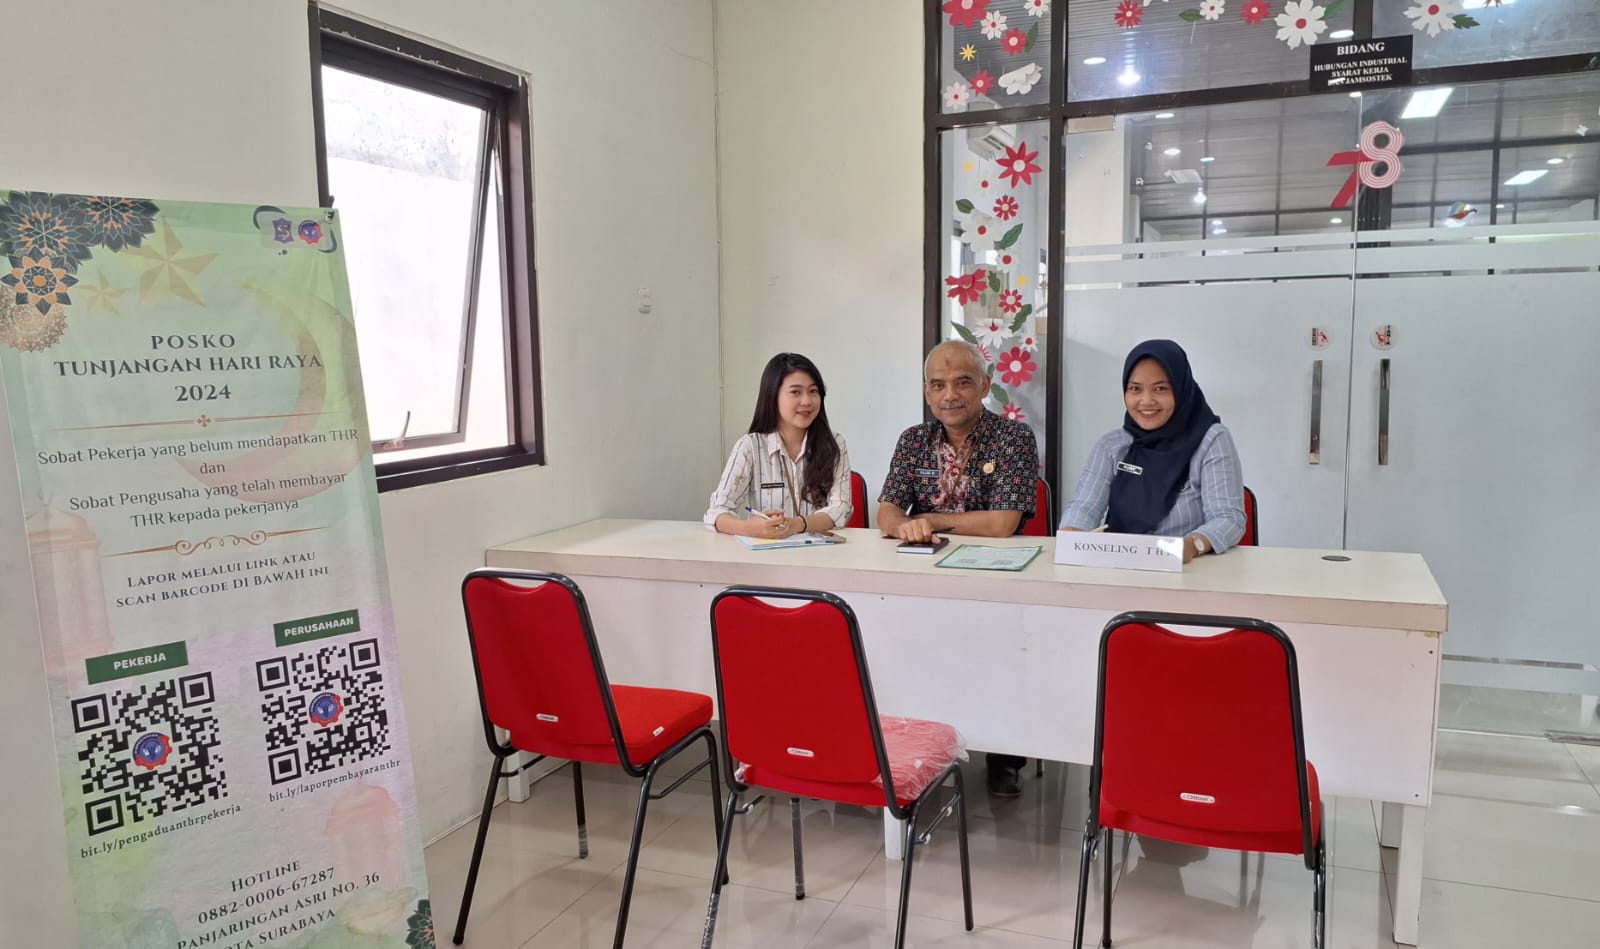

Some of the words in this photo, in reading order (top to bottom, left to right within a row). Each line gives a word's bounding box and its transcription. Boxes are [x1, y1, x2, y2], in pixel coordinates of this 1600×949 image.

[1337, 42, 1385, 56] BIDANG
[1314, 61, 1358, 72] HUBUNGAN
[1359, 56, 1408, 67] INDUSTRIAL
[1331, 69, 1362, 78] SYARAT
[1363, 66, 1389, 75] KERJA
[1345, 74, 1393, 84] JAMSOSTEK
[151, 333, 236, 351] POSKO
[54, 356, 202, 378] TUNJANGAN
[209, 355, 261, 372] HARI
[269, 354, 323, 370] RAYA
[174, 384, 232, 402] 2024
[38, 448, 84, 466] Sobat
[88, 445, 146, 463] Pekerja
[151, 443, 187, 460] yang
[190, 437, 234, 454] belum
[237, 430, 327, 450] mendapatkan
[329, 428, 360, 442] THR
[199, 461, 226, 475] dan
[69, 495, 116, 511] Sobat
[120, 486, 200, 508] Pengusaha
[204, 483, 239, 501] yang
[242, 477, 276, 494] telah
[279, 472, 348, 491] membayar
[130, 512, 165, 528] THR
[169, 506, 220, 526] kepada
[224, 499, 299, 520] pekerjanya
[1074, 542, 1137, 554] KONSELING
[127, 571, 177, 588] LAPOR
[181, 564, 242, 580] MELALUI
[246, 557, 279, 571] LINK
[281, 551, 316, 565] ATAU
[116, 593, 156, 608] SCAN
[161, 581, 229, 601] BARCODE
[233, 576, 250, 589] DI
[253, 569, 305, 587] BAWAH
[309, 565, 329, 578] INI
[284, 616, 354, 638] PERUSAHAAN
[113, 652, 166, 670] PEKERJA
[268, 758, 401, 802] bit.ly/laporpembayaranthr
[81, 803, 242, 858] bit.ly/pengaduanthrpekerja
[231, 860, 300, 892] HOTLINE
[198, 867, 335, 924] 0882-0006-67287
[177, 904, 289, 949] PANJARINGAN
[294, 891, 327, 911] ASRI
[332, 881, 360, 897] NO.
[363, 872, 380, 887] 36
[258, 908, 336, 945] SURABAYA
